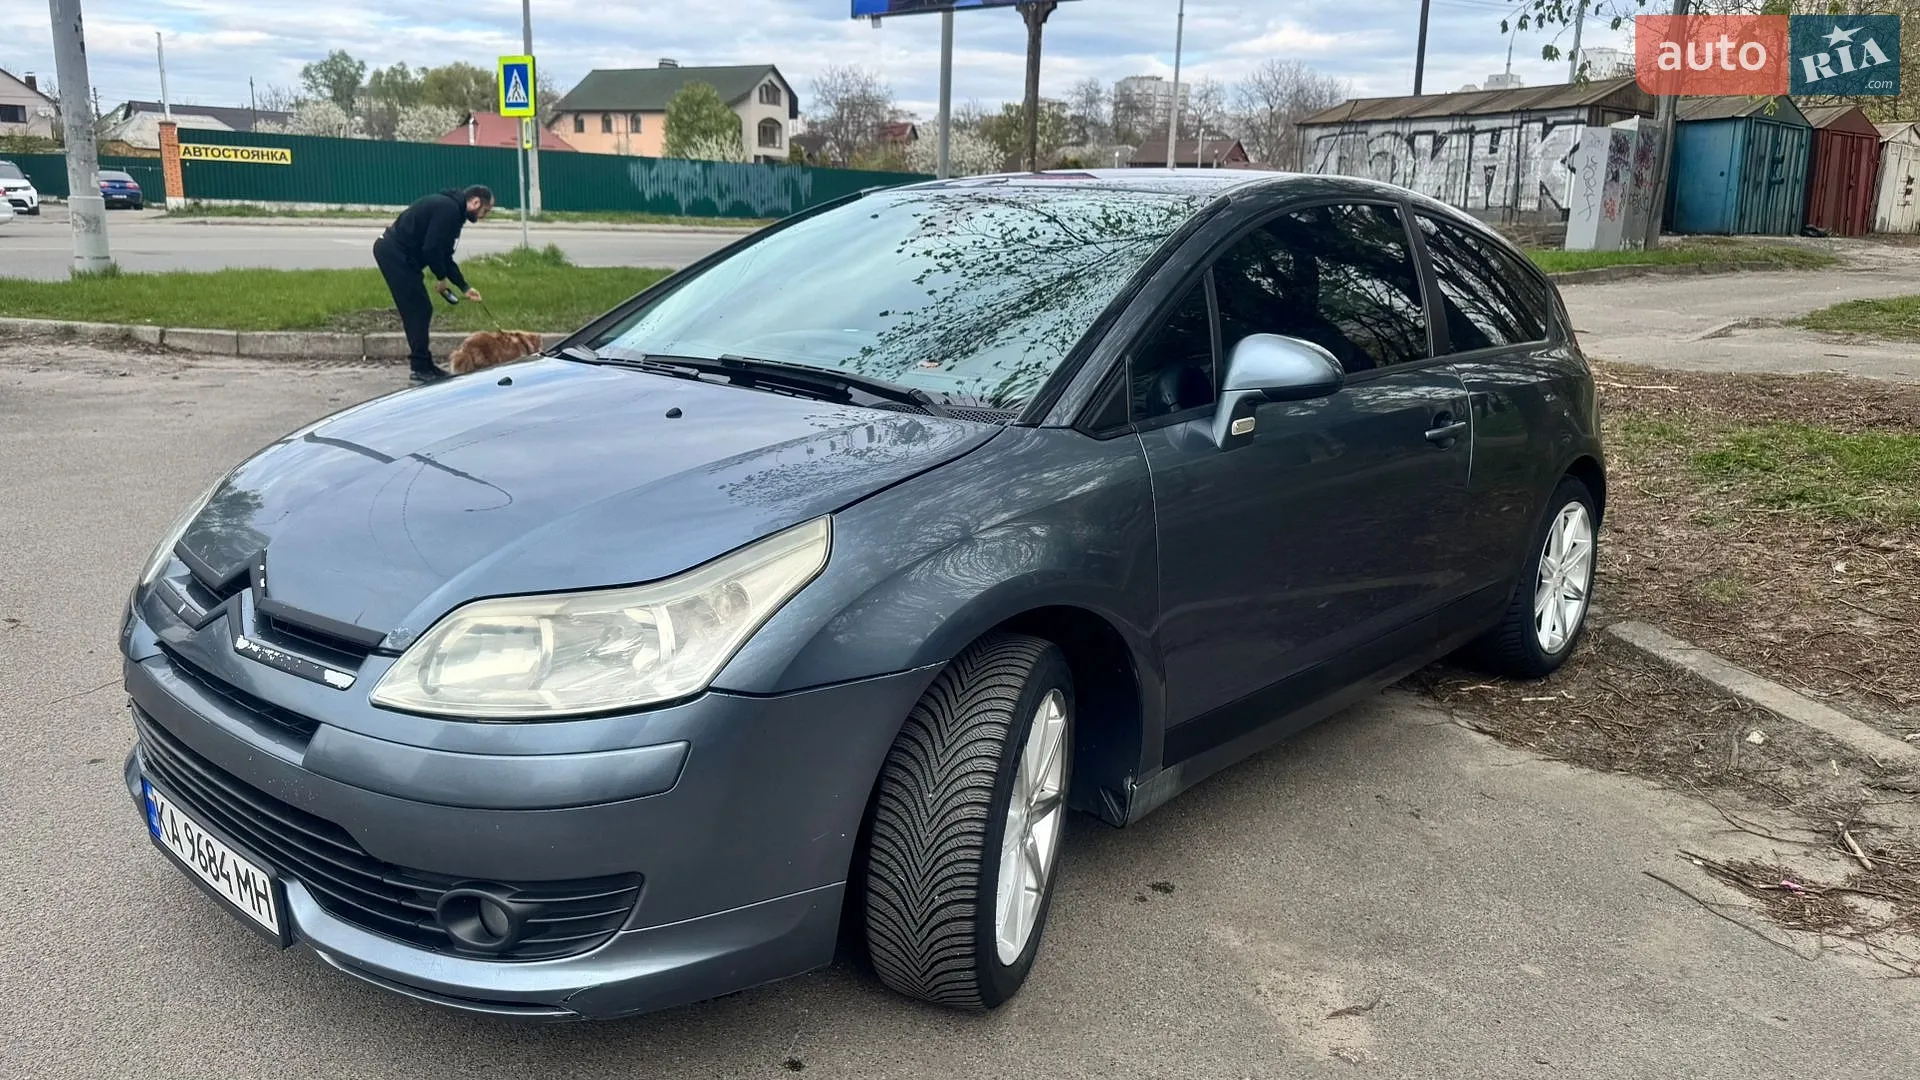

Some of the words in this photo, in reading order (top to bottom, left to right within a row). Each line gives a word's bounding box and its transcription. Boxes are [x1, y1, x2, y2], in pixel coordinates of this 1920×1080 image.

[182, 146, 289, 162] АВТОСТОЯНКА
[154, 795, 184, 854] KA
[184, 822, 234, 895] 9684
[233, 858, 274, 924] MH
